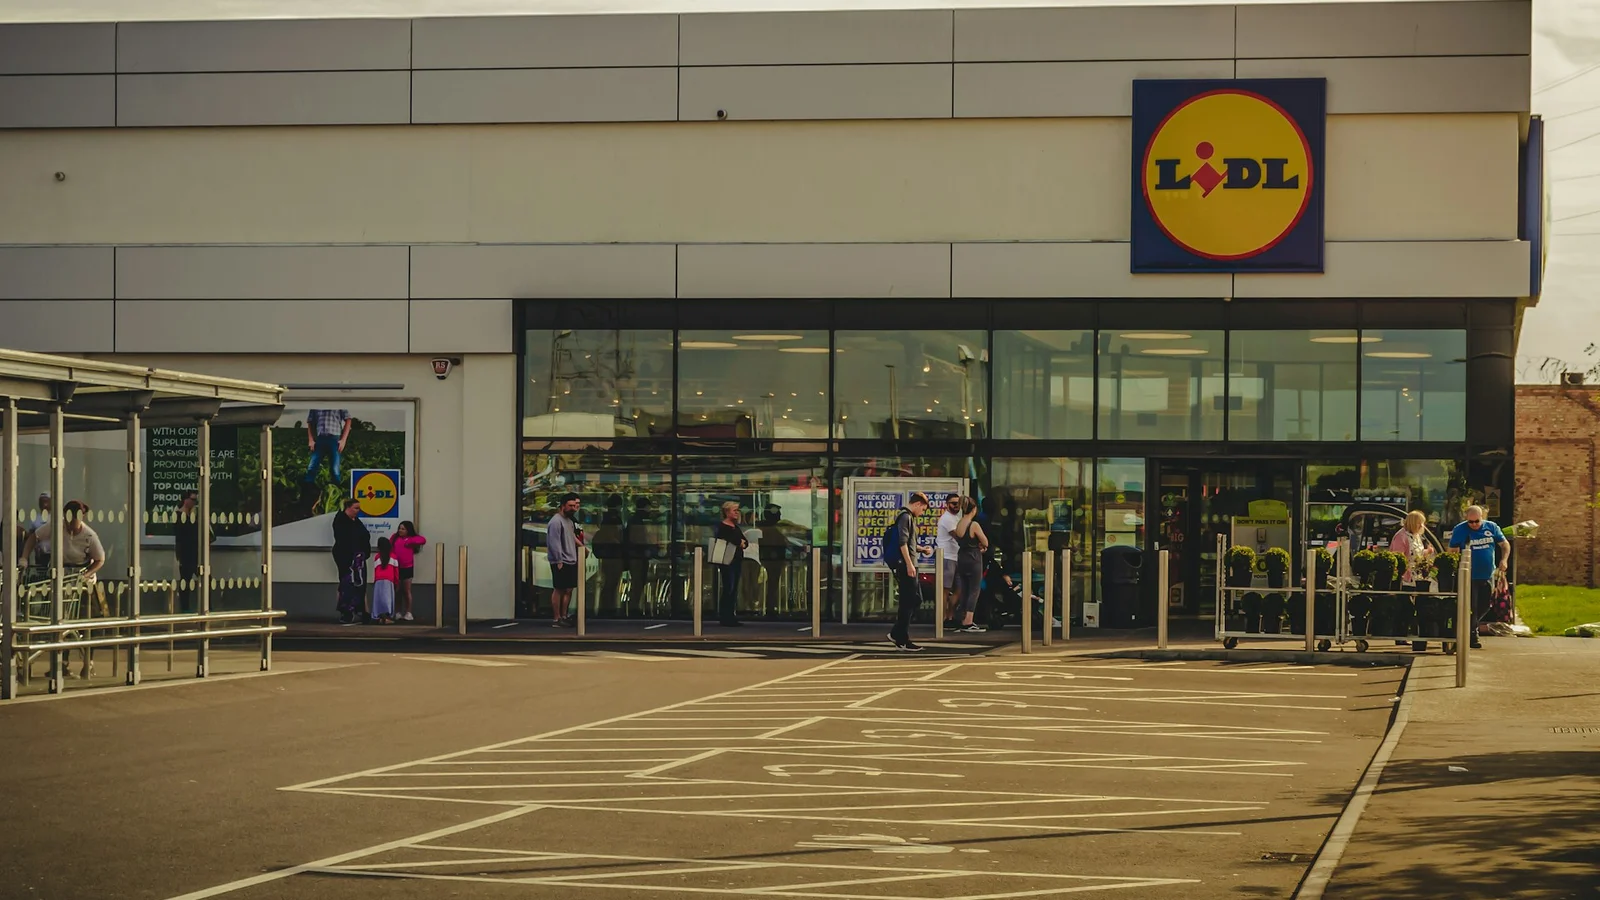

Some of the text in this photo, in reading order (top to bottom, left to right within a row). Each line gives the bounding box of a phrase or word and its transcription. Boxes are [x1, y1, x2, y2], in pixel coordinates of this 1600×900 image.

[152, 428, 198, 436] WITH OUR
[152, 438, 198, 447] SUPPLIERS
[152, 450, 165, 458] TO
[217, 450, 235, 459] ARE
[153, 471, 233, 480] CUSTOME WITH
[152, 482, 212, 492] TOP QUAL
[152, 504, 164, 513] AT
[857, 501, 896, 509] ALL OUR
[857, 517, 896, 527] SPECIA
[857, 526, 886, 537] OFFE
[857, 537, 883, 546] IN-ST
[857, 546, 884, 559] NO
